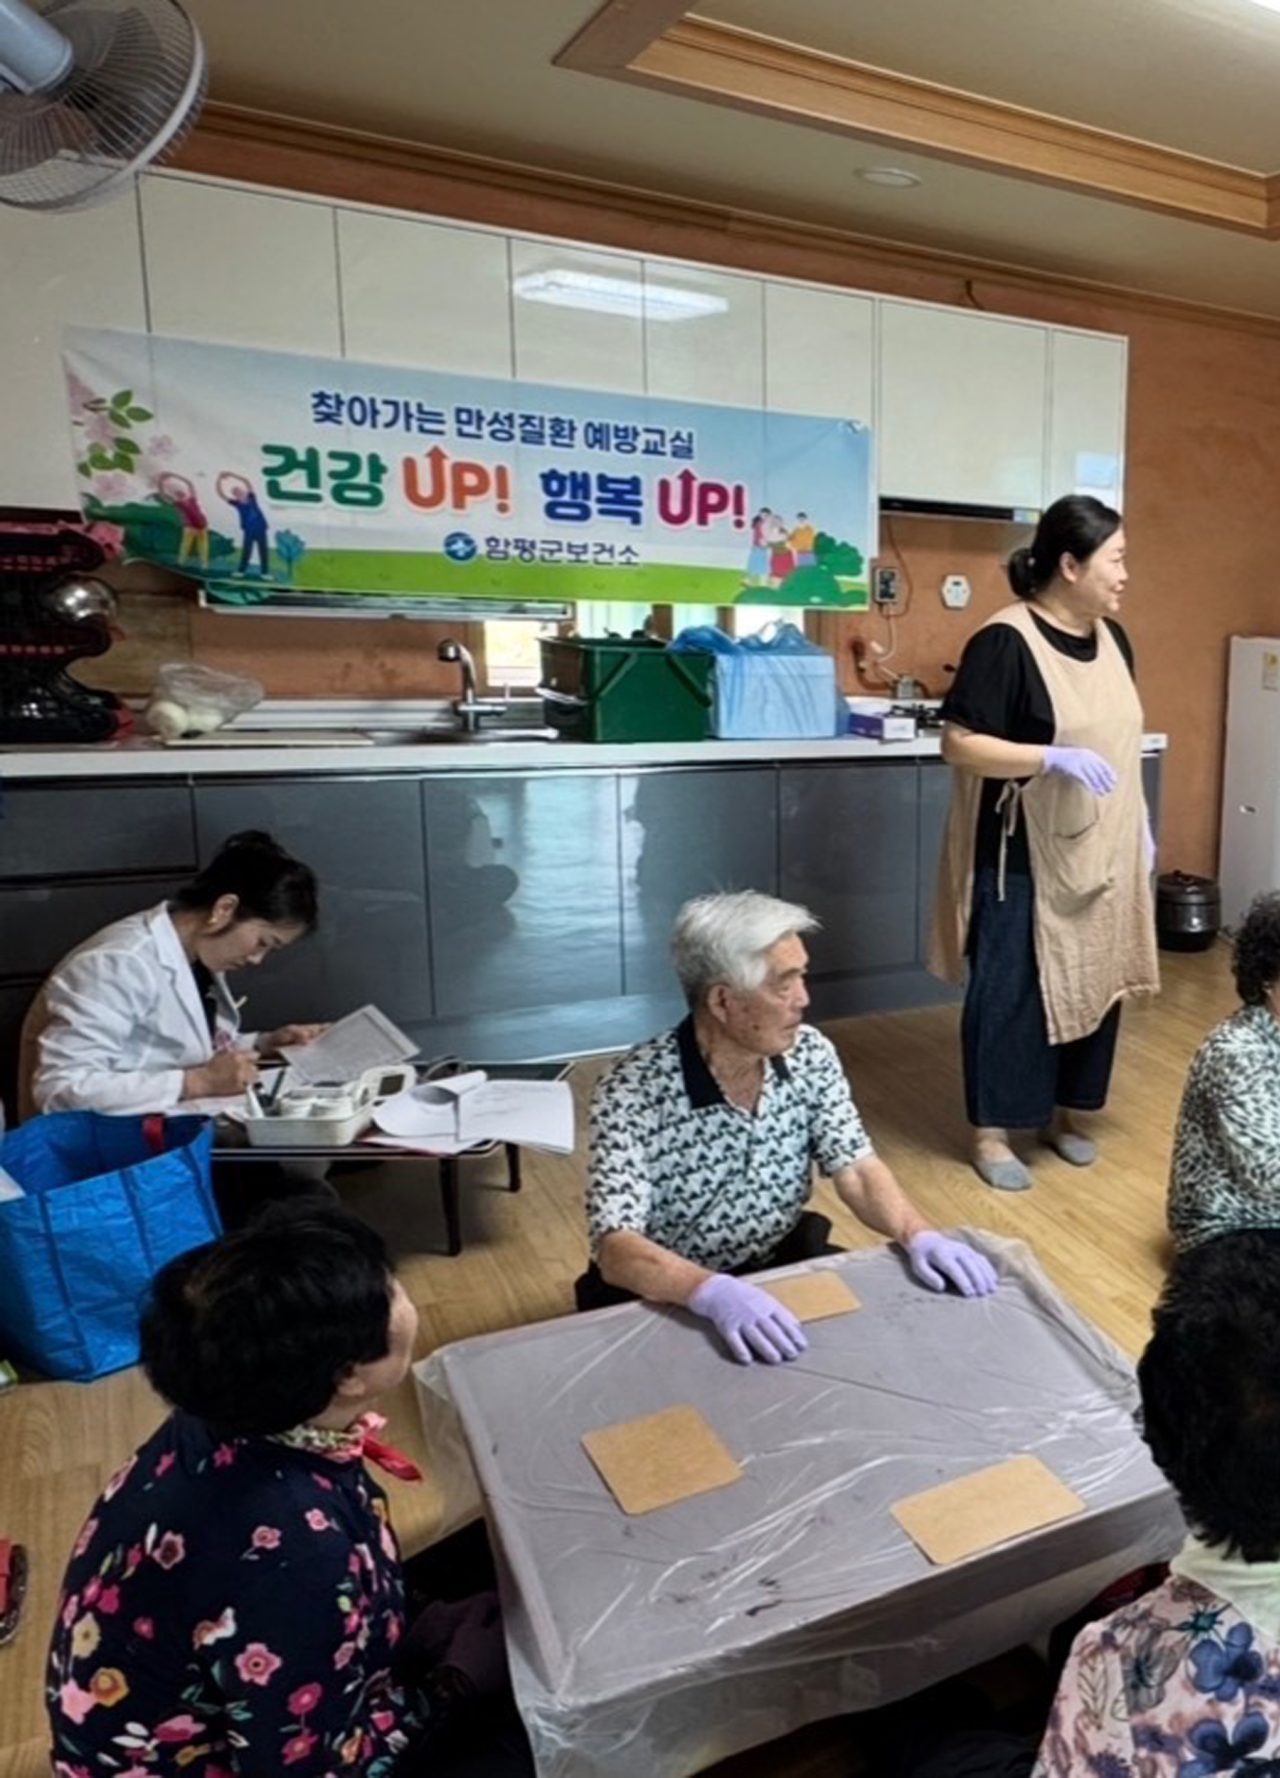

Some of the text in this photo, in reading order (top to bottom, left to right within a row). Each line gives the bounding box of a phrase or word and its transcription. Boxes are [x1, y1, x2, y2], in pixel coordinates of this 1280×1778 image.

[311, 390, 694, 460] 찾아가는 만성질환 예방교실
[260, 444, 745, 529] 건강 UP! 행복 UP!
[484, 536, 640, 567] 함평군보건소
